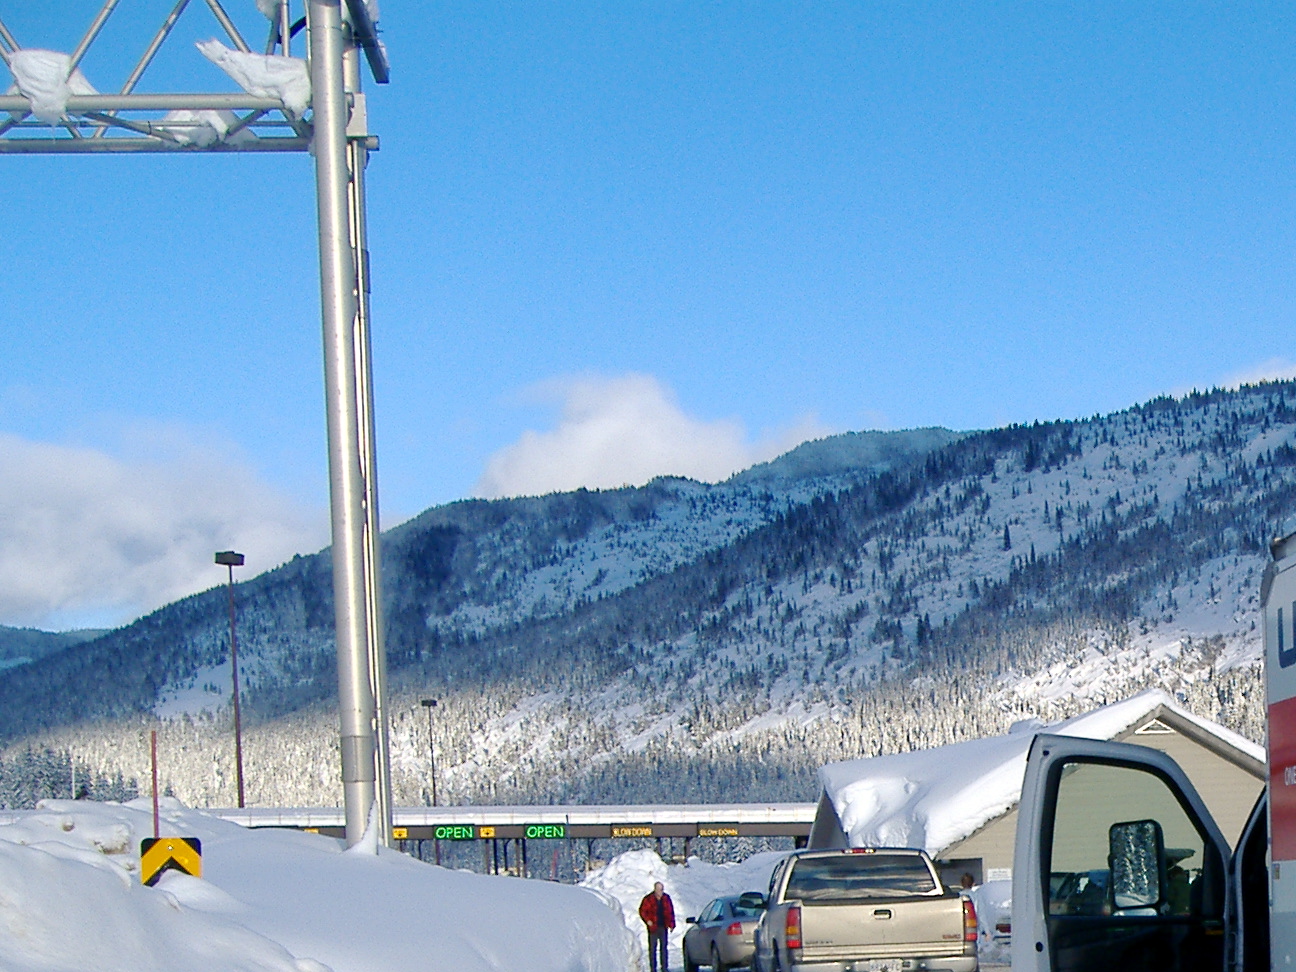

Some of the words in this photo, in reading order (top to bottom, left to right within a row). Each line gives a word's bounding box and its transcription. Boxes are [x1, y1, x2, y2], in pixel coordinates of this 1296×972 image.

[435, 826, 473, 838] OPEN
[526, 825, 564, 838] OPEN
[613, 827, 631, 836] SLOW
[632, 827, 652, 836] DOWN
[718, 828, 737, 836] DOWN
